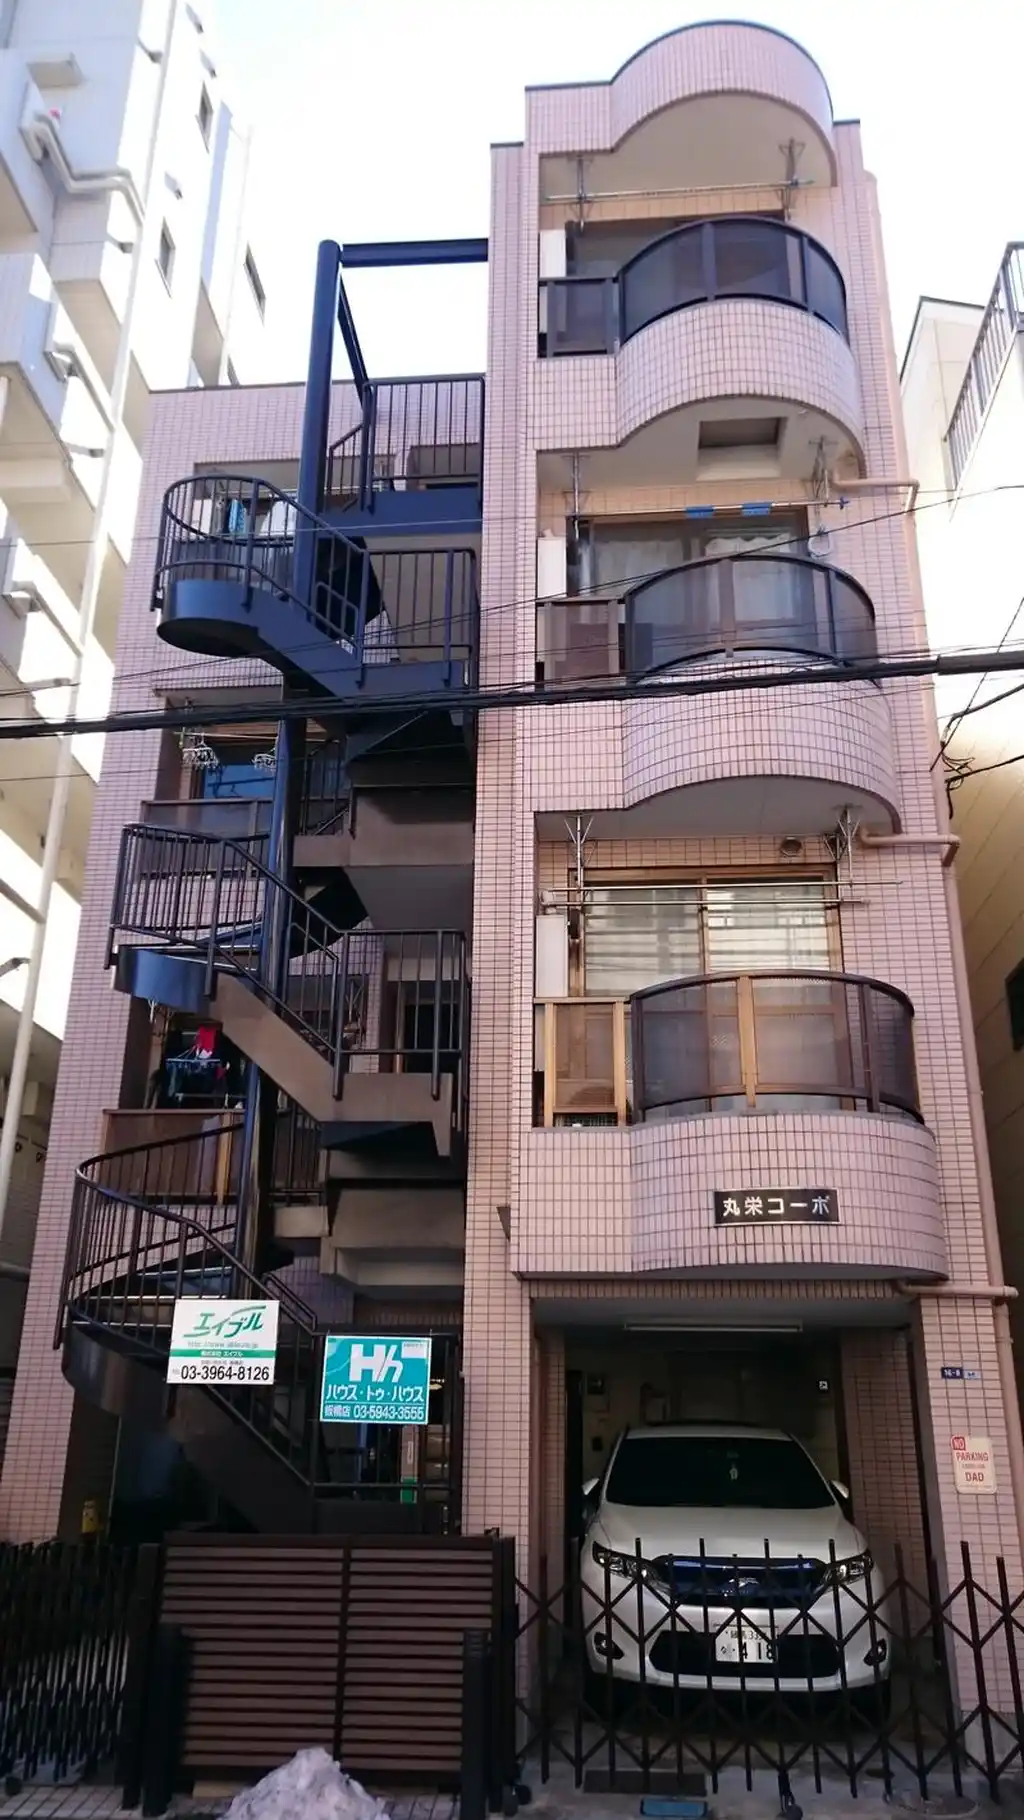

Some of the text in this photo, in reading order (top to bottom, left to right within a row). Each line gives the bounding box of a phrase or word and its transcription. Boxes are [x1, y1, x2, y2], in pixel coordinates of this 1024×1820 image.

[723, 1196, 830, 1216] 丸栄コーポ
[183, 1305, 267, 1338] エイブル
[181, 1365, 270, 1381] 03-3964-8126
[954, 1439, 964, 1449] NO
[956, 1452, 988, 1461] PARKING
[965, 1472, 984, 1481] DAD
